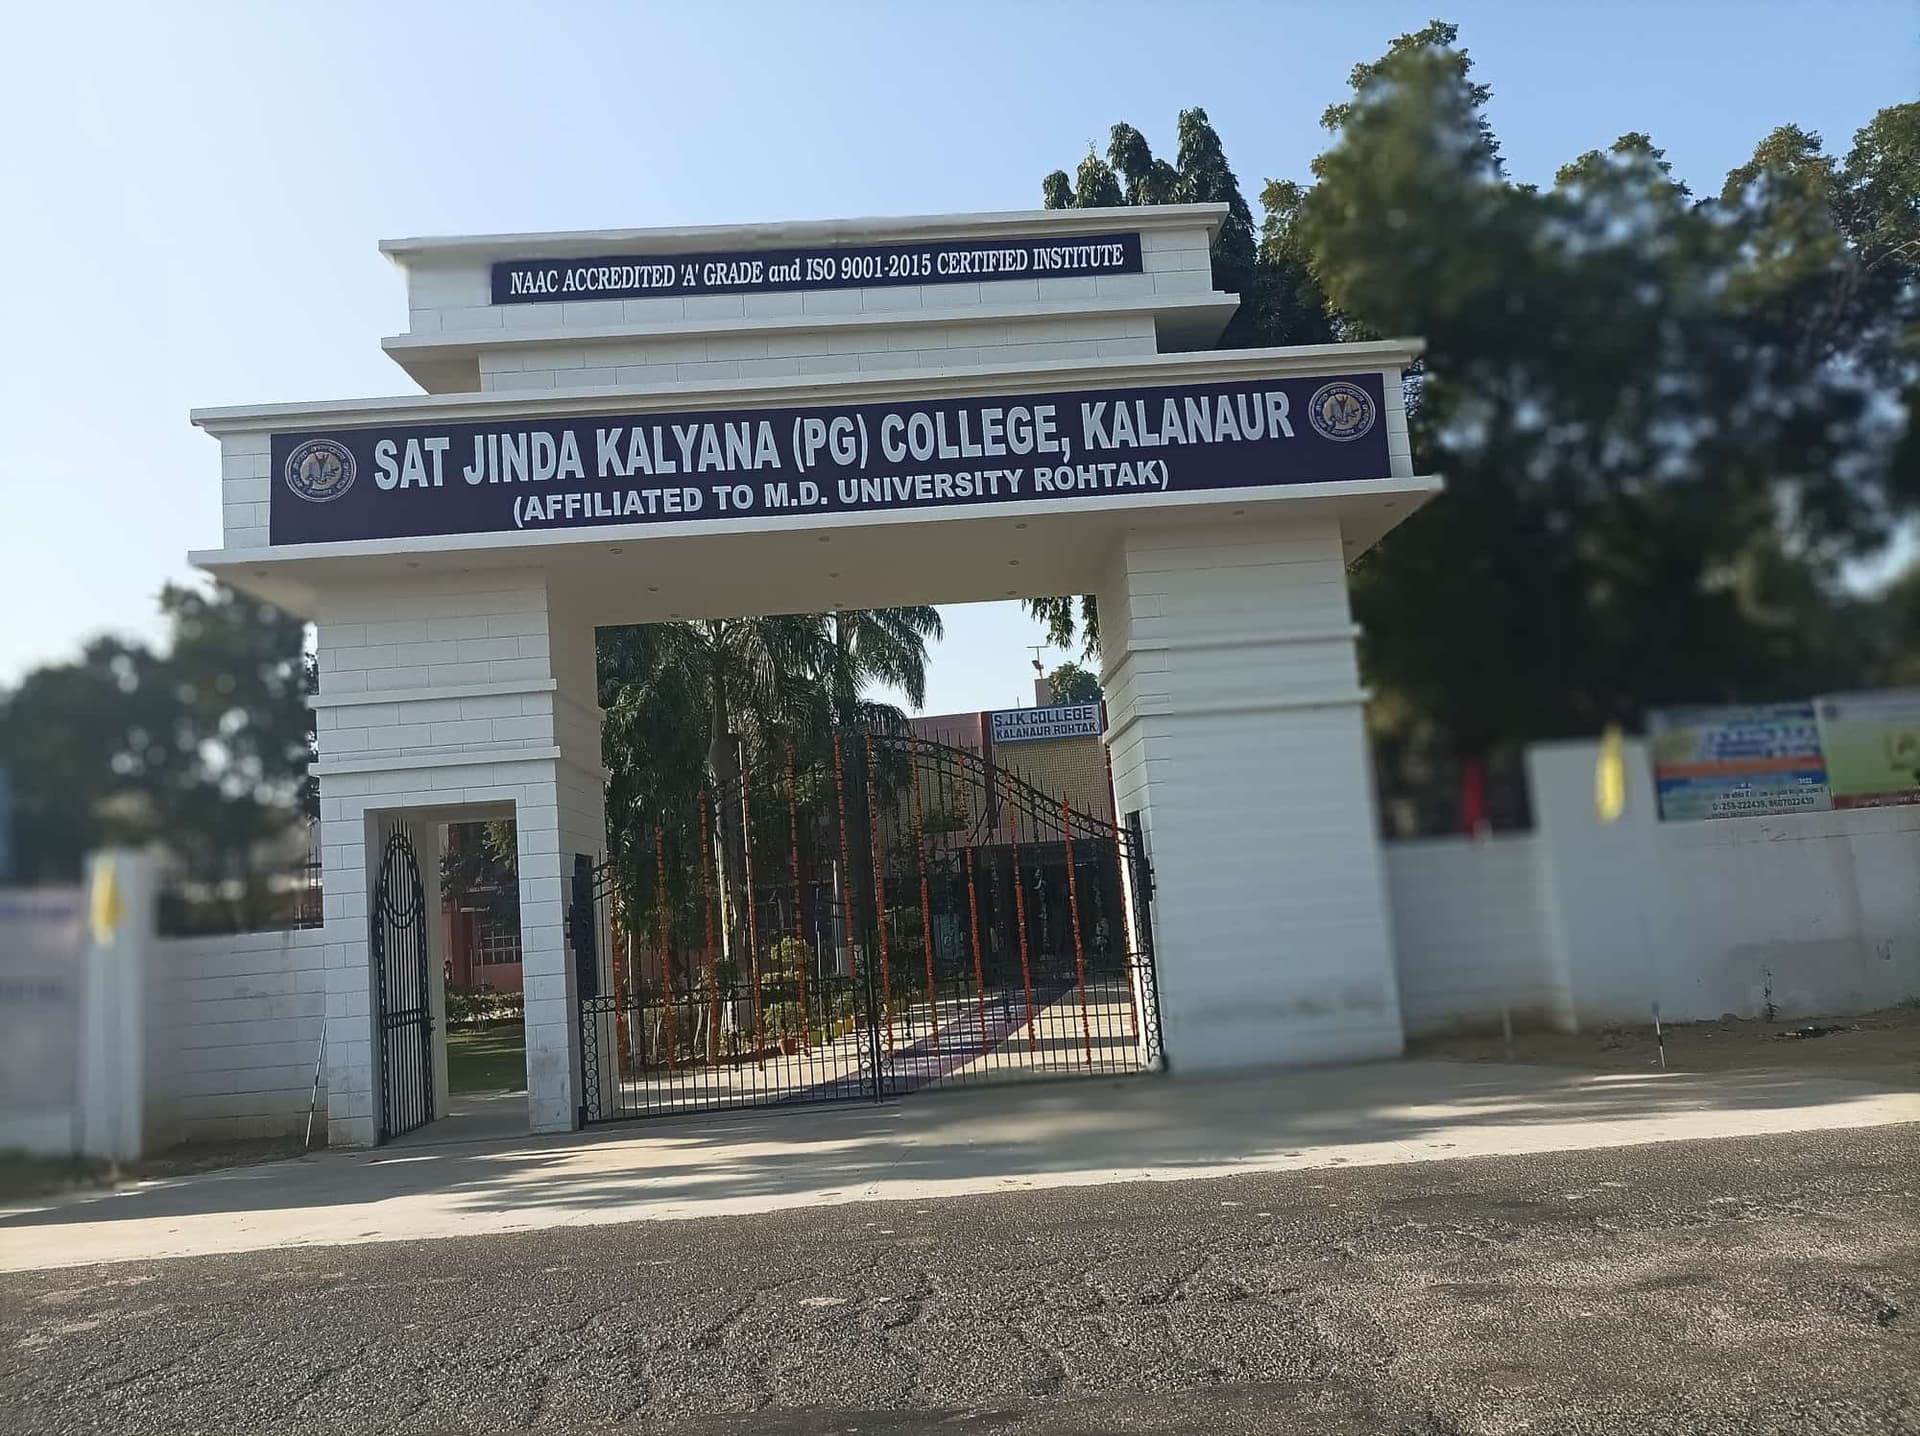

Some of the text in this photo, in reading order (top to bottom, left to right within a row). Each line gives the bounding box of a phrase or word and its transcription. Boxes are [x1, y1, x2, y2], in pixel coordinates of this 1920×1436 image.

[510, 244, 1123, 294] NAAC ACCREDITED 'A' GRADE and ISO 9001-2015 CERTIFIED INSTITUTE
[374, 436, 450, 490] SAT
[463, 431, 585, 485] JINDA
[597, 421, 782, 477] KALYANA
[793, 414, 868, 472] (PG)
[881, 405, 1070, 463] COLLEGE,
[1081, 391, 1295, 449] KALANAUR
[513, 460, 1168, 528] (AFFILIATED TO M.D. UNIVERSITY ROHTAK)
